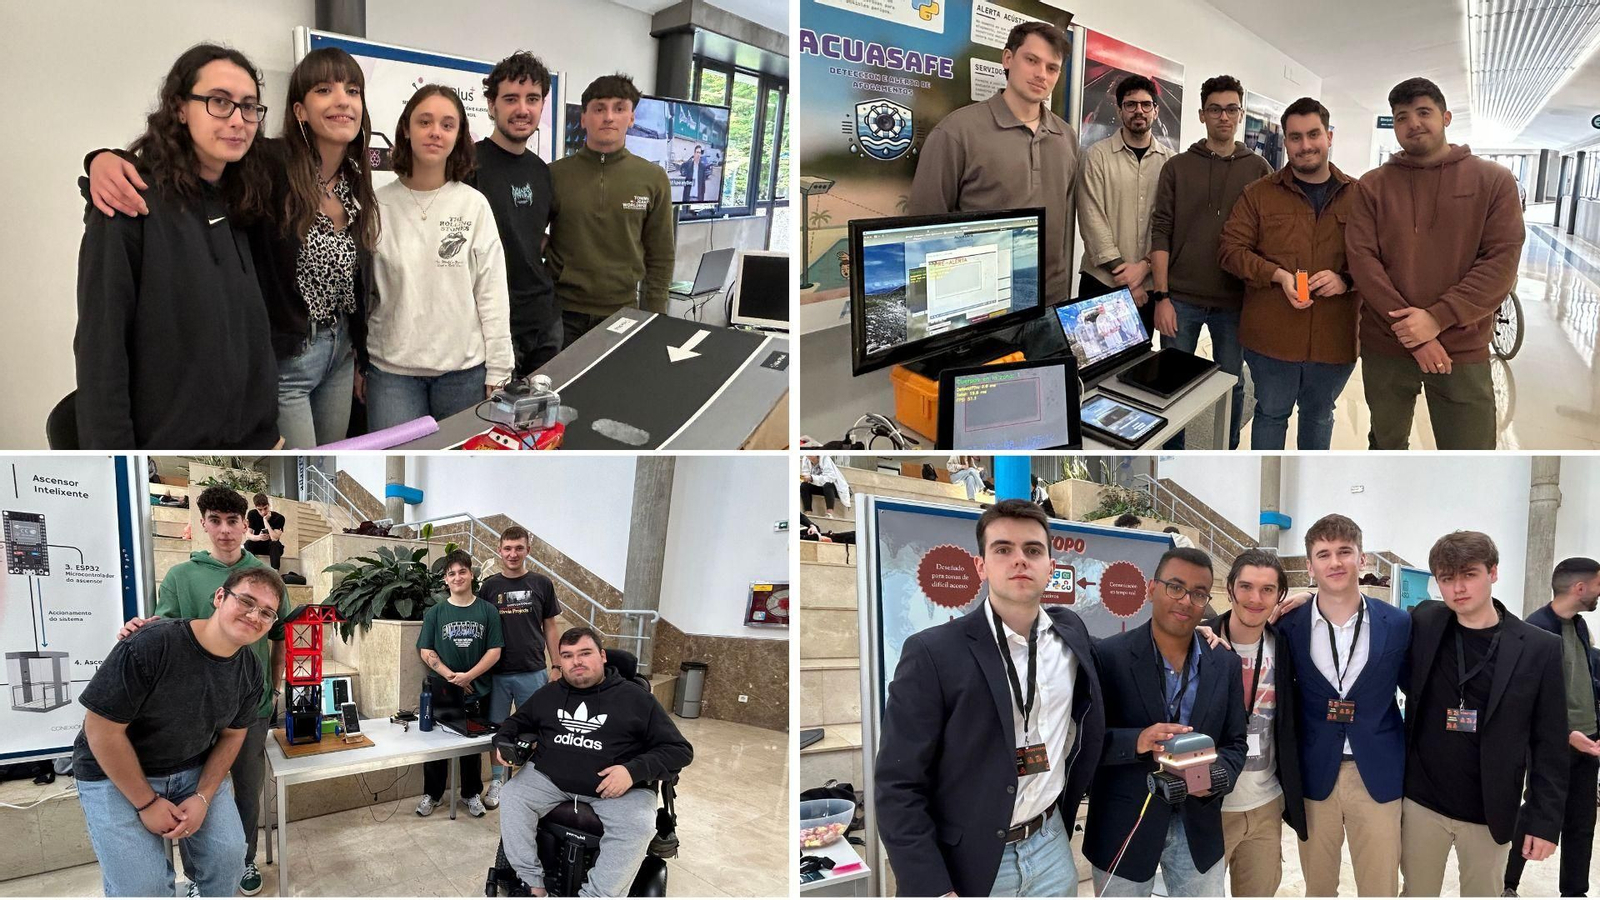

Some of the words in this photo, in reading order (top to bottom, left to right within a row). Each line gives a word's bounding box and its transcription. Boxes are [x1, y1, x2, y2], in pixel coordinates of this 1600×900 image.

[976, 4, 1000, 18] ALERTA
[800, 29, 953, 80] ACUASAFE
[852, 81, 914, 96] AFOGAMENTOS
[888, 75, 920, 88] ALERTA
[920, 81, 931, 89] DE
[33, 474, 79, 487] Ascensor
[34, 485, 89, 499] Intelixente
[1051, 535, 1086, 555] OPO
[65, 563, 73, 571] 3.
[75, 564, 100, 572] ESP32
[65, 571, 115, 579] Microcontrolador
[554, 733, 602, 750] adidas
